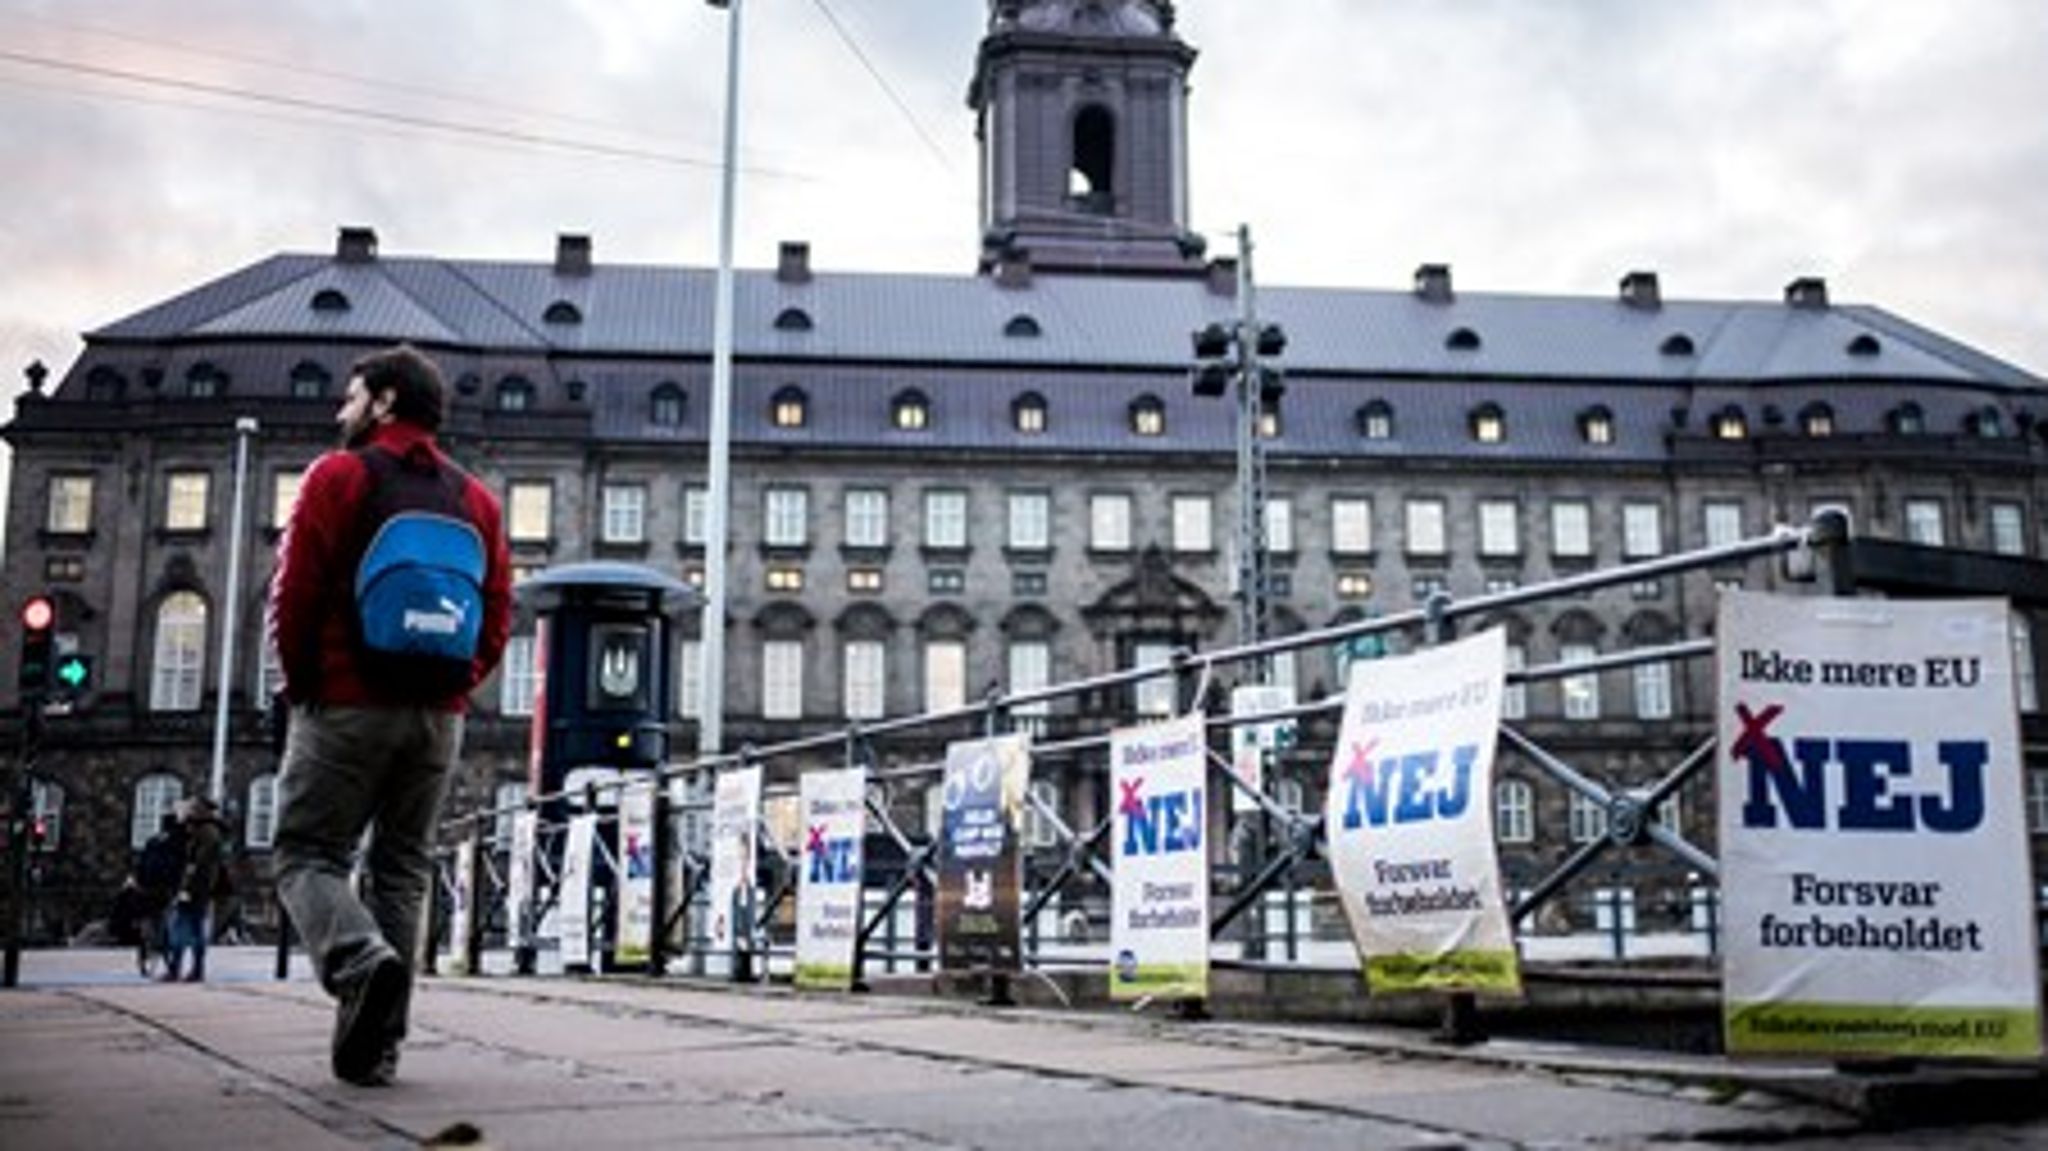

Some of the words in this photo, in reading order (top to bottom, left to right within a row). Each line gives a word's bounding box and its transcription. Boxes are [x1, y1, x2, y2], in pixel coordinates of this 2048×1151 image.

[1740, 650, 1813, 684] Ikke
[1821, 662, 1916, 687] mere
[1924, 657, 1980, 687] EU
[1344, 744, 1479, 829] NEJ
[1743, 736, 1989, 832] NEJ
[1374, 859, 1453, 883] Forsvar
[1366, 886, 1483, 915] forbeholdet
[1792, 873, 1940, 907] Forsvar
[1760, 915, 1982, 951] forbeholdet
[1920, 1016, 1969, 1038] mod
[1975, 1017, 2007, 1039] EU
